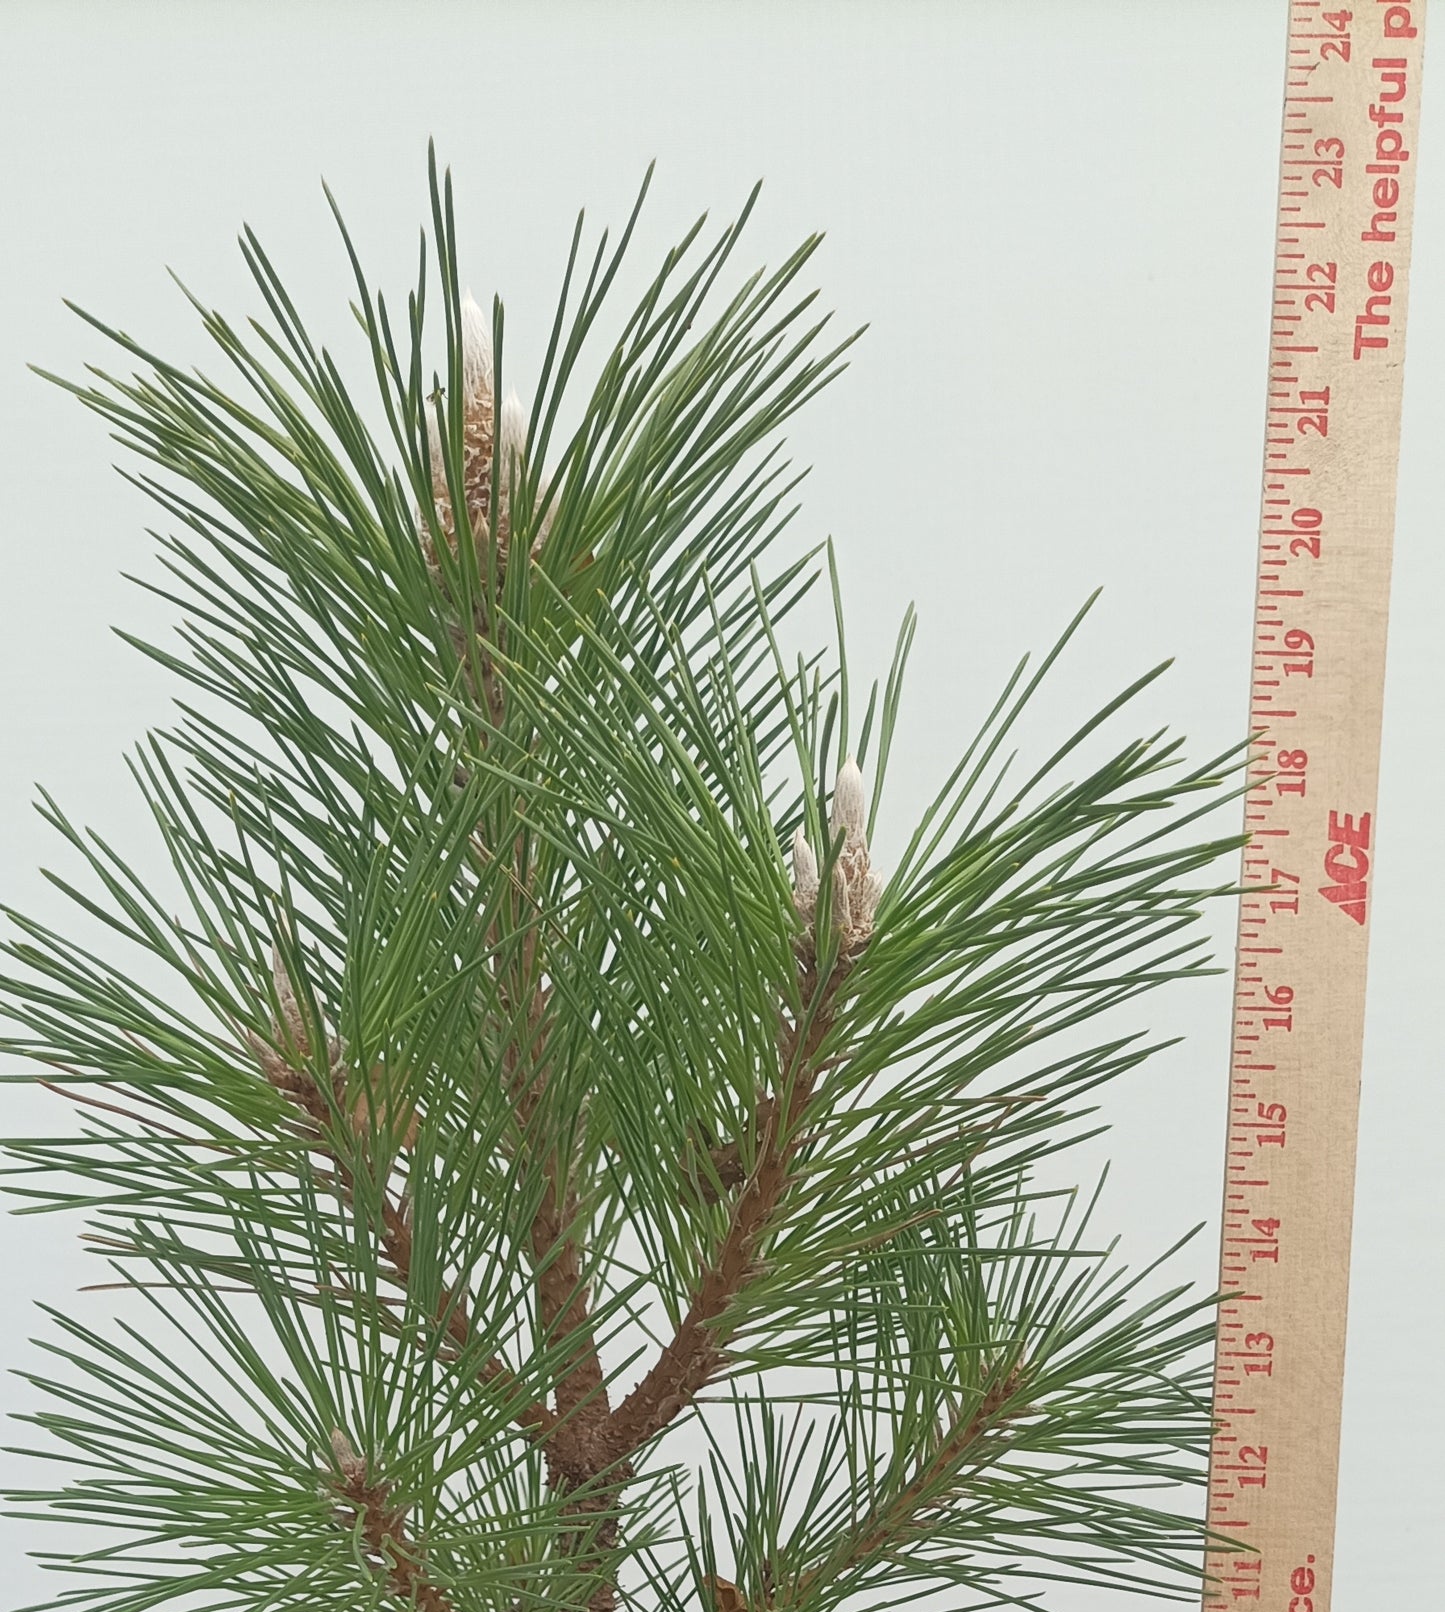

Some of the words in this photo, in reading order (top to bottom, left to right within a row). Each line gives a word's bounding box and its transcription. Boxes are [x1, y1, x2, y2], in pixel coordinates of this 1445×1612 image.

[1320, 9, 1353, 63] 24
[1376, 0, 1418, 38] p
[1312, 137, 1345, 189] 23
[1362, 58, 1409, 242] helpful
[1305, 262, 1338, 314] 22
[1353, 260, 1393, 360] The
[1297, 385, 1330, 437] 21
[1289, 508, 1323, 559] 20
[1283, 629, 1315, 678] 19
[1276, 749, 1308, 798] 18
[1269, 868, 1300, 915] 17
[1317, 809, 1371, 926] ACE
[1262, 985, 1294, 1033] 16
[1256, 1102, 1287, 1149] 15
[1249, 1217, 1281, 1263] 14
[1243, 1332, 1274, 1378] 13
[1236, 1445, 1268, 1489] 12
[1232, 1558, 1262, 1601] 11
